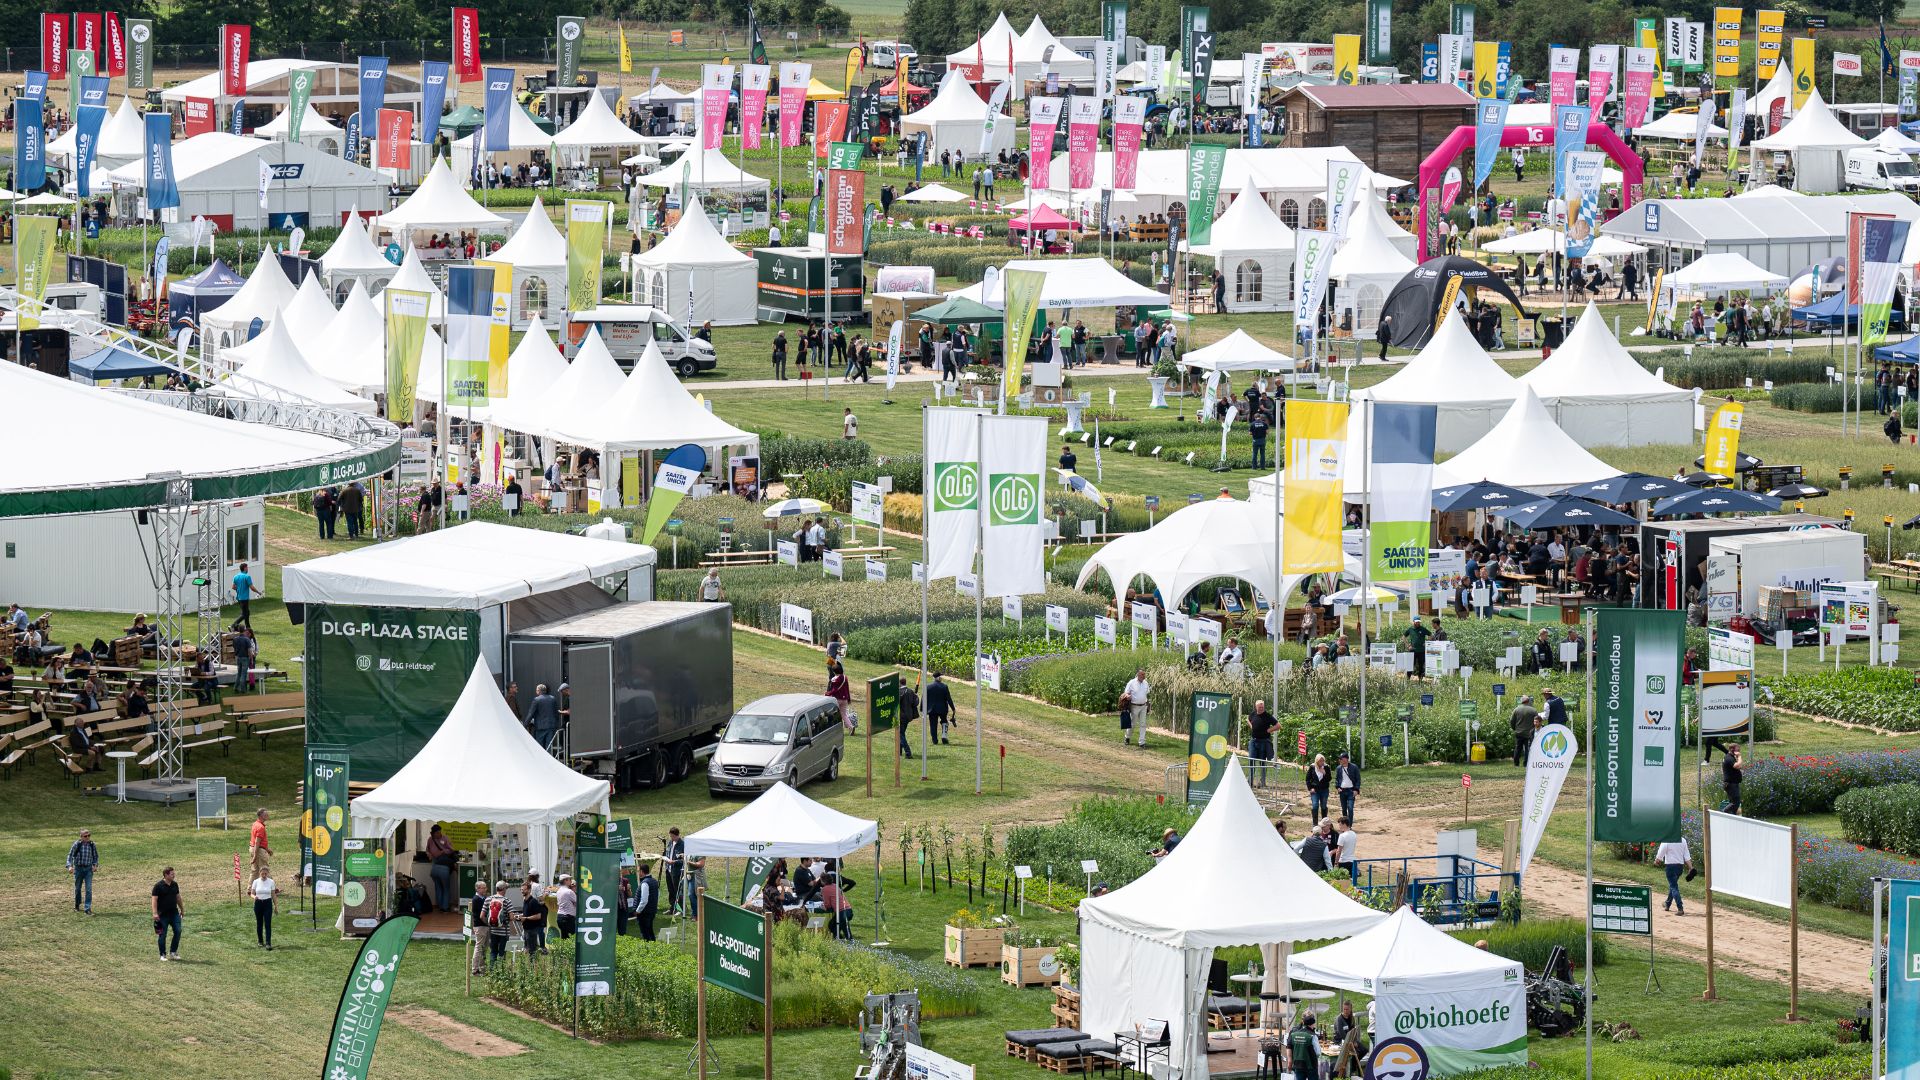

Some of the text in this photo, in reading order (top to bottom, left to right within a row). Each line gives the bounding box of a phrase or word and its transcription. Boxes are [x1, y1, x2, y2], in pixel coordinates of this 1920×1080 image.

[85, 19, 93, 51] ORSCH
[110, 19, 123, 60] HORSCH
[463, 15, 471, 58] HORSCH
[1672, 21, 1680, 56] ZÜRN
[1760, 25, 1783, 33] JCB
[53, 21, 61, 64] HORSCH
[1689, 26, 1698, 61] ZÜRN
[234, 33, 242, 79] HORSCH
[1717, 55, 1739, 63] JCB
[1759, 58, 1778, 66] JCB
[1251, 59, 1260, 93] PLANTAN
[234, 110, 243, 136] ptima
[346, 123, 357, 160] Optima
[1190, 150, 1206, 201] BayWa
[1848, 160, 1861, 170] BTU
[833, 175, 856, 247] schaumann group
[1048, 299, 1072, 307] BayWa
[612, 322, 640, 330] Protecting
[453, 380, 485, 390] SAATEN
[457, 389, 485, 398] UNION
[332, 461, 367, 480] DLG-PLAZA
[665, 471, 688, 481] SAATEN
[667, 478, 687, 486] UNION
[945, 467, 973, 499] DLG
[1000, 478, 1029, 512] DLG
[1382, 546, 1426, 559] SAATEN
[1388, 557, 1426, 569] UNION
[321, 621, 469, 641] DLG-PLAZA STAGE
[789, 615, 811, 636] MultiTec
[405, 662, 434, 671] Feldtage
[1608, 635, 1621, 710] Ökolandbau
[1196, 697, 1217, 711] dip
[1708, 703, 1748, 711] SACHSEN-ANHALT
[315, 765, 334, 780] dip
[1532, 762, 1564, 770] LIGNOVIS
[1606, 717, 1620, 818] DLG-SPOTLIGHT
[1530, 776, 1551, 823] Agroforst
[749, 842, 765, 853] dip
[582, 895, 610, 946] dip
[709, 929, 760, 962] DLG-SPOTLIGHT
[719, 954, 751, 979] Ökolandbau
[1504, 967, 1518, 976] BÖL
[335, 949, 380, 1063] FERTINAGRO
[1394, 1000, 1511, 1035] @biohoefe
[348, 992, 380, 1068] BIOTECH
